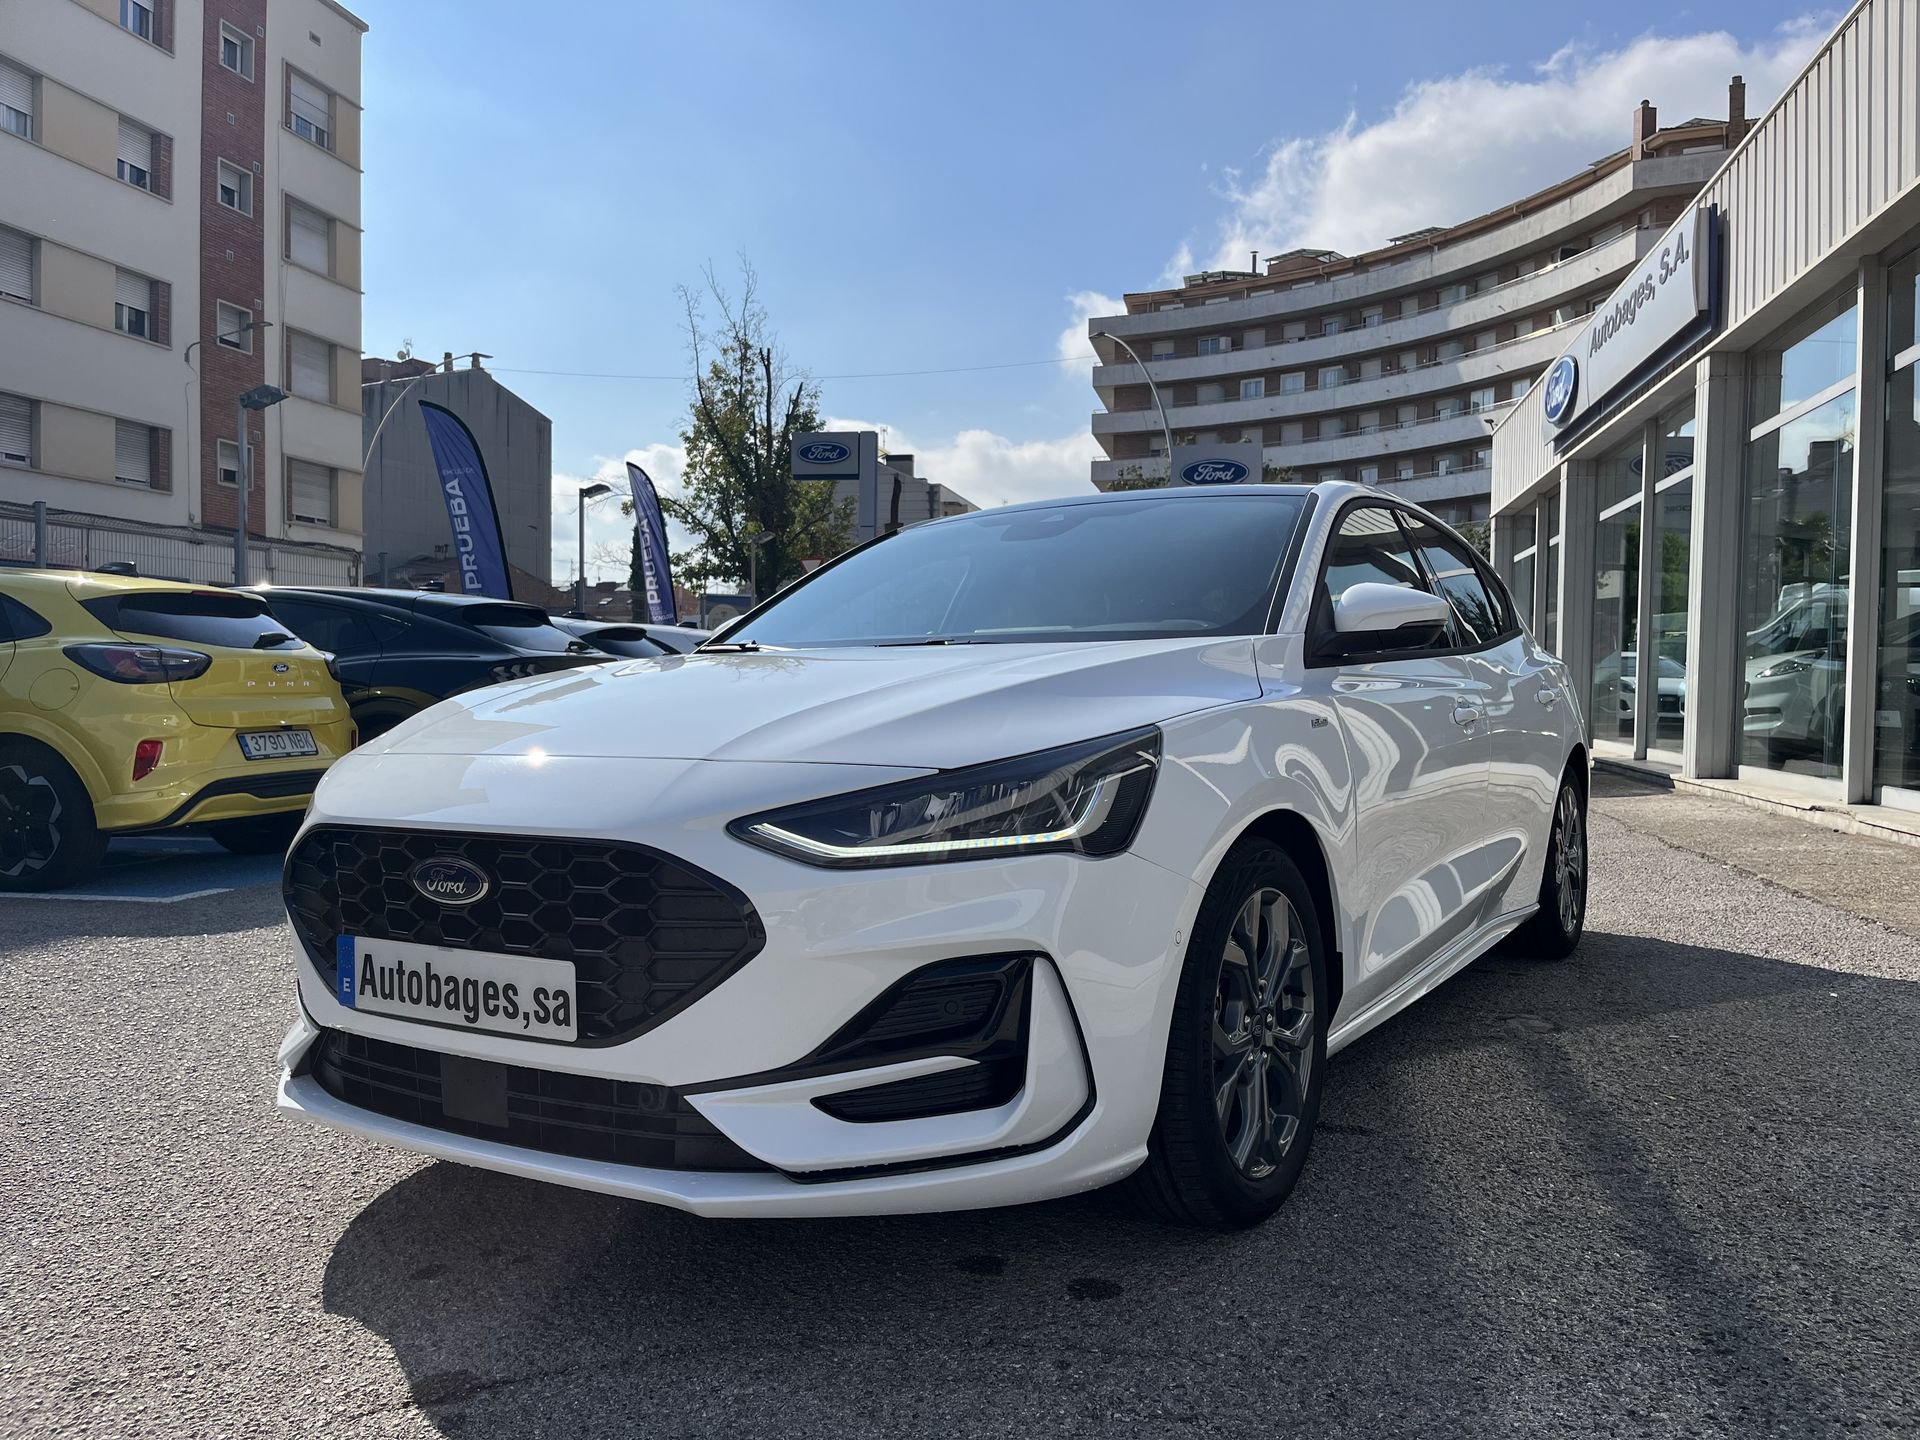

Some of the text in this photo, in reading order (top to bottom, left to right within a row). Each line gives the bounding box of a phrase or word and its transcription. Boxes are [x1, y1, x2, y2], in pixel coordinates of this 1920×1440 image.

[1589, 231, 1690, 358] Autobages, S.A.
[808, 445, 840, 459] Ford
[1193, 463, 1236, 481] Ford
[445, 477, 482, 589] PRUEBA
[640, 517, 661, 604] PRUEBA
[250, 732, 313, 753] 3790 NBK
[426, 866, 466, 895] Ford
[343, 978, 350, 992] E
[359, 953, 572, 1030] Autobages,sa
